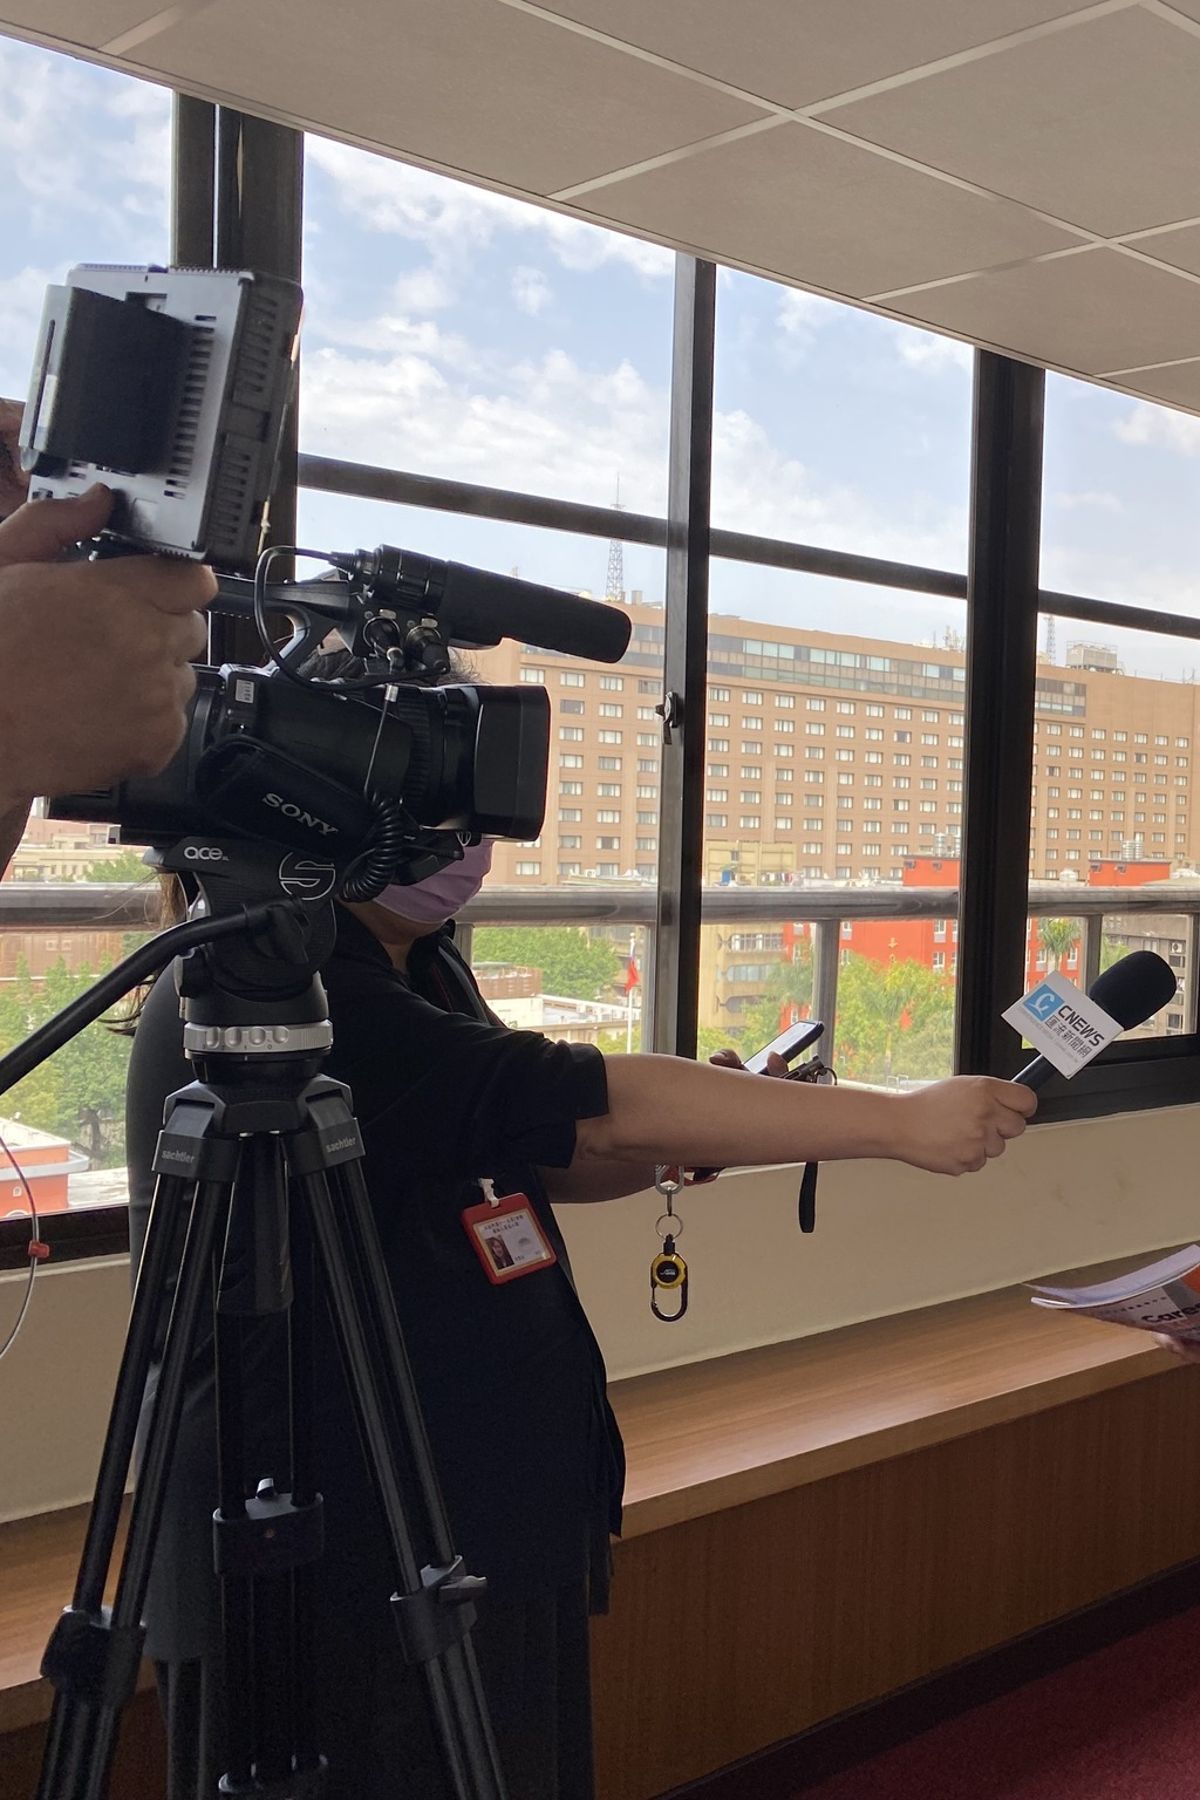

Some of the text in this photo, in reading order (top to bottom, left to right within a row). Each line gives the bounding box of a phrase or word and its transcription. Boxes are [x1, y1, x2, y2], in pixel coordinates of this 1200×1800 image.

[262, 793, 339, 836] SONY
[184, 846, 223, 860] ace
[1058, 1005, 1104, 1047] CNEWS
